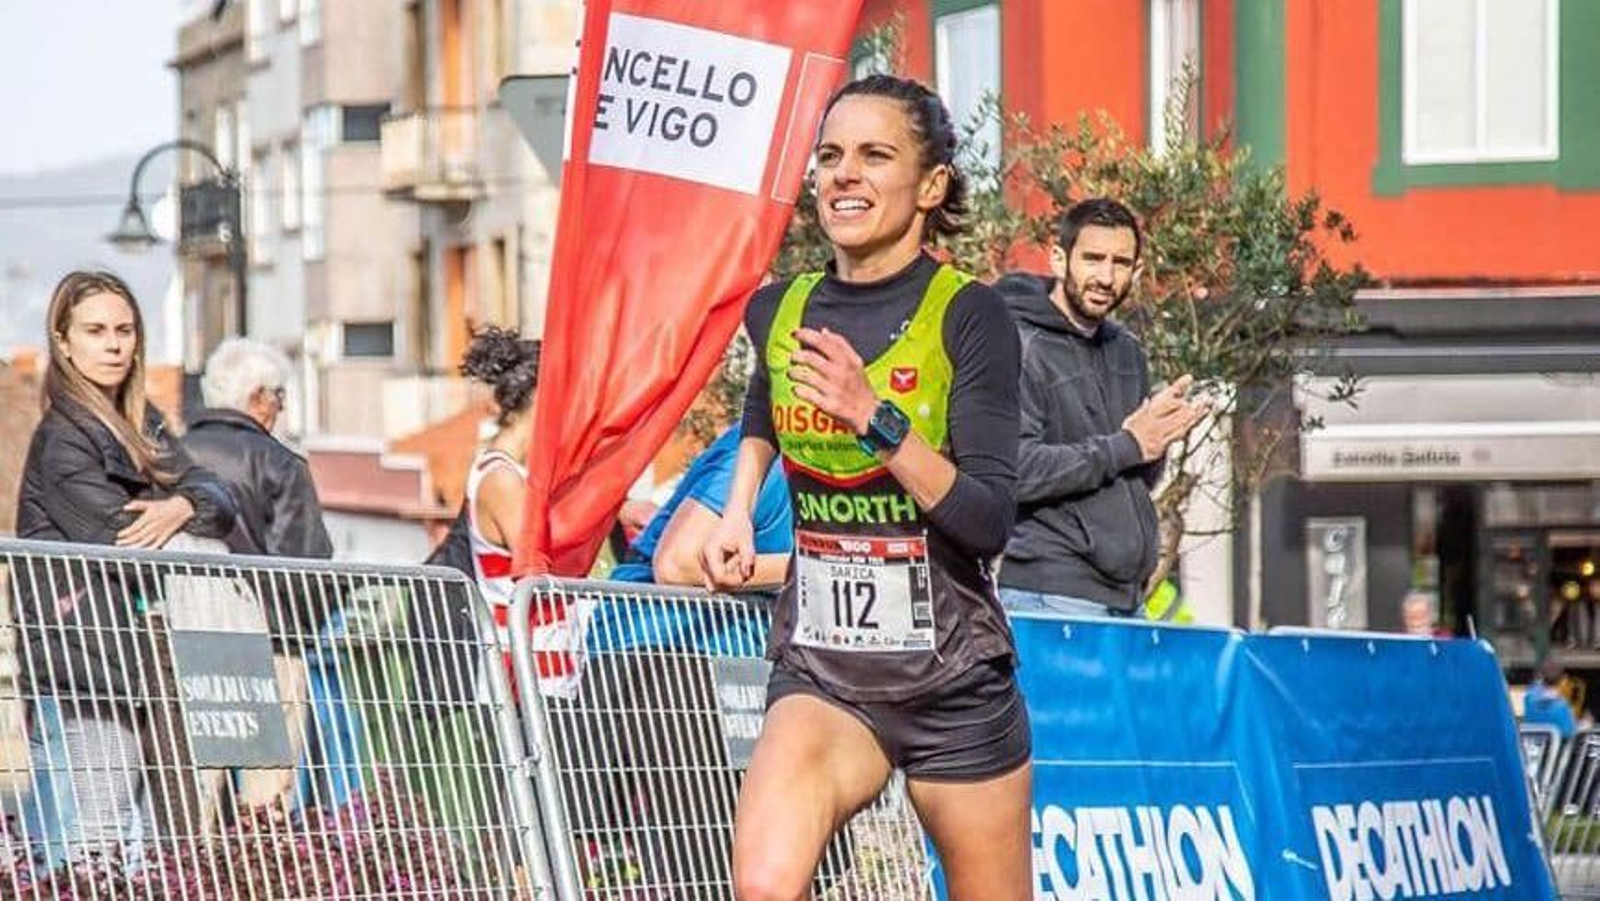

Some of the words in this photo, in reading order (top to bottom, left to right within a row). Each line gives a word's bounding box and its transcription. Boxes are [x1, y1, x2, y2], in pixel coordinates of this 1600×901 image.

[604, 46, 758, 108] NCELLO
[626, 98, 719, 148] VIGO
[832, 580, 879, 629] 112
[188, 709, 260, 739] EVENTS
[1311, 795, 1512, 901] DECATHLON
